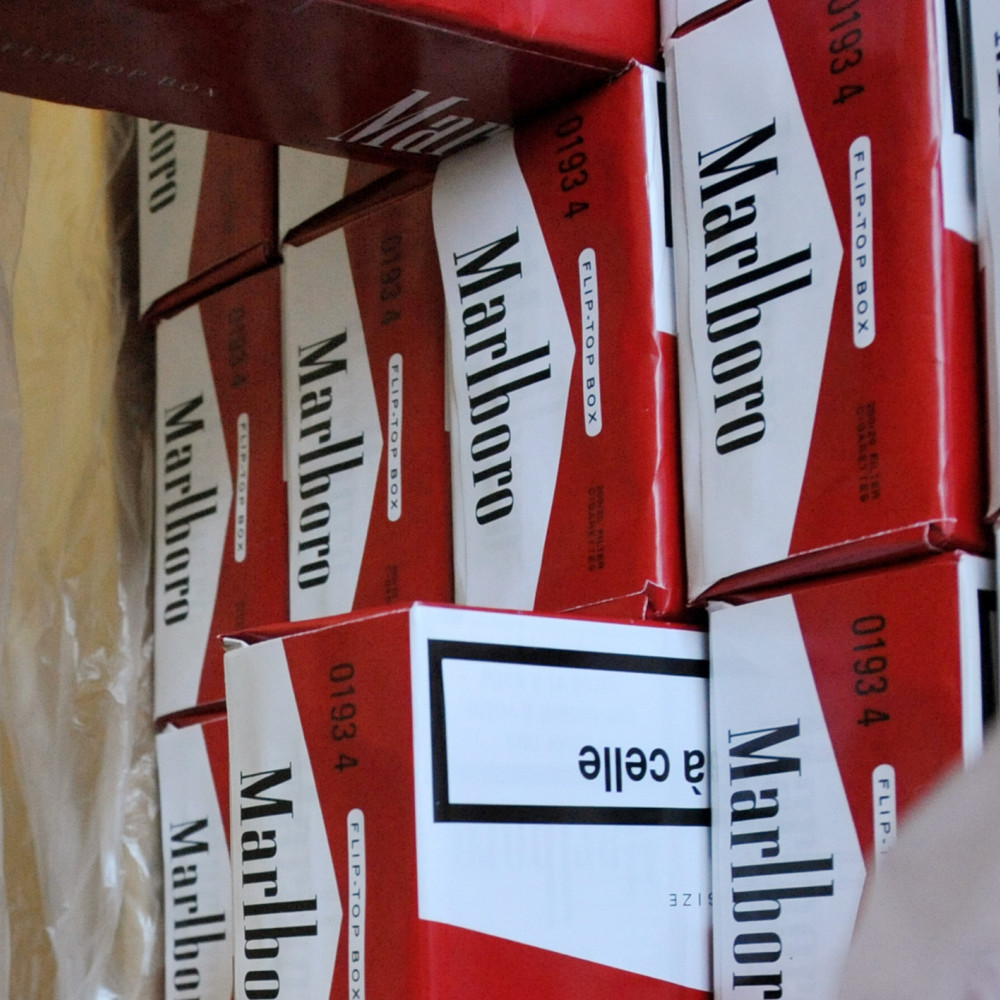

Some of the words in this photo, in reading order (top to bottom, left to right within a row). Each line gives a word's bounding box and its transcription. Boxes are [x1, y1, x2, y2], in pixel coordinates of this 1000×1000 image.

[156, 76, 217, 97] BOX
[833, 84, 864, 106] 4
[555, 116, 589, 193] 0193
[564, 201, 590, 219] 4
[854, 151, 867, 268] FLIP-TOP
[583, 261, 595, 365] FLIP-TOP
[698, 116, 812, 455] Marlboro
[856, 283, 868, 334] BOX
[453, 226, 551, 526] Marlboro
[585, 377, 597, 424] BOX
[390, 364, 399, 458] FLIP-TOP
[237, 422, 249, 506] FLIP-TOP
[297, 327, 365, 590] Marlboro
[390, 469, 399, 510] BOX
[164, 391, 218, 626] Marlboro
[236, 514, 246, 551] BOX
[852, 614, 889, 696] 0193
[329, 662, 356, 742] 0193
[857, 708, 890, 728] 4
[333, 753, 359, 773] 4
[578, 745, 670, 793] celle
[683, 750, 706, 796] à
[350, 822, 361, 938] FLIP-TOP
[351, 951, 361, 1000] BOX
